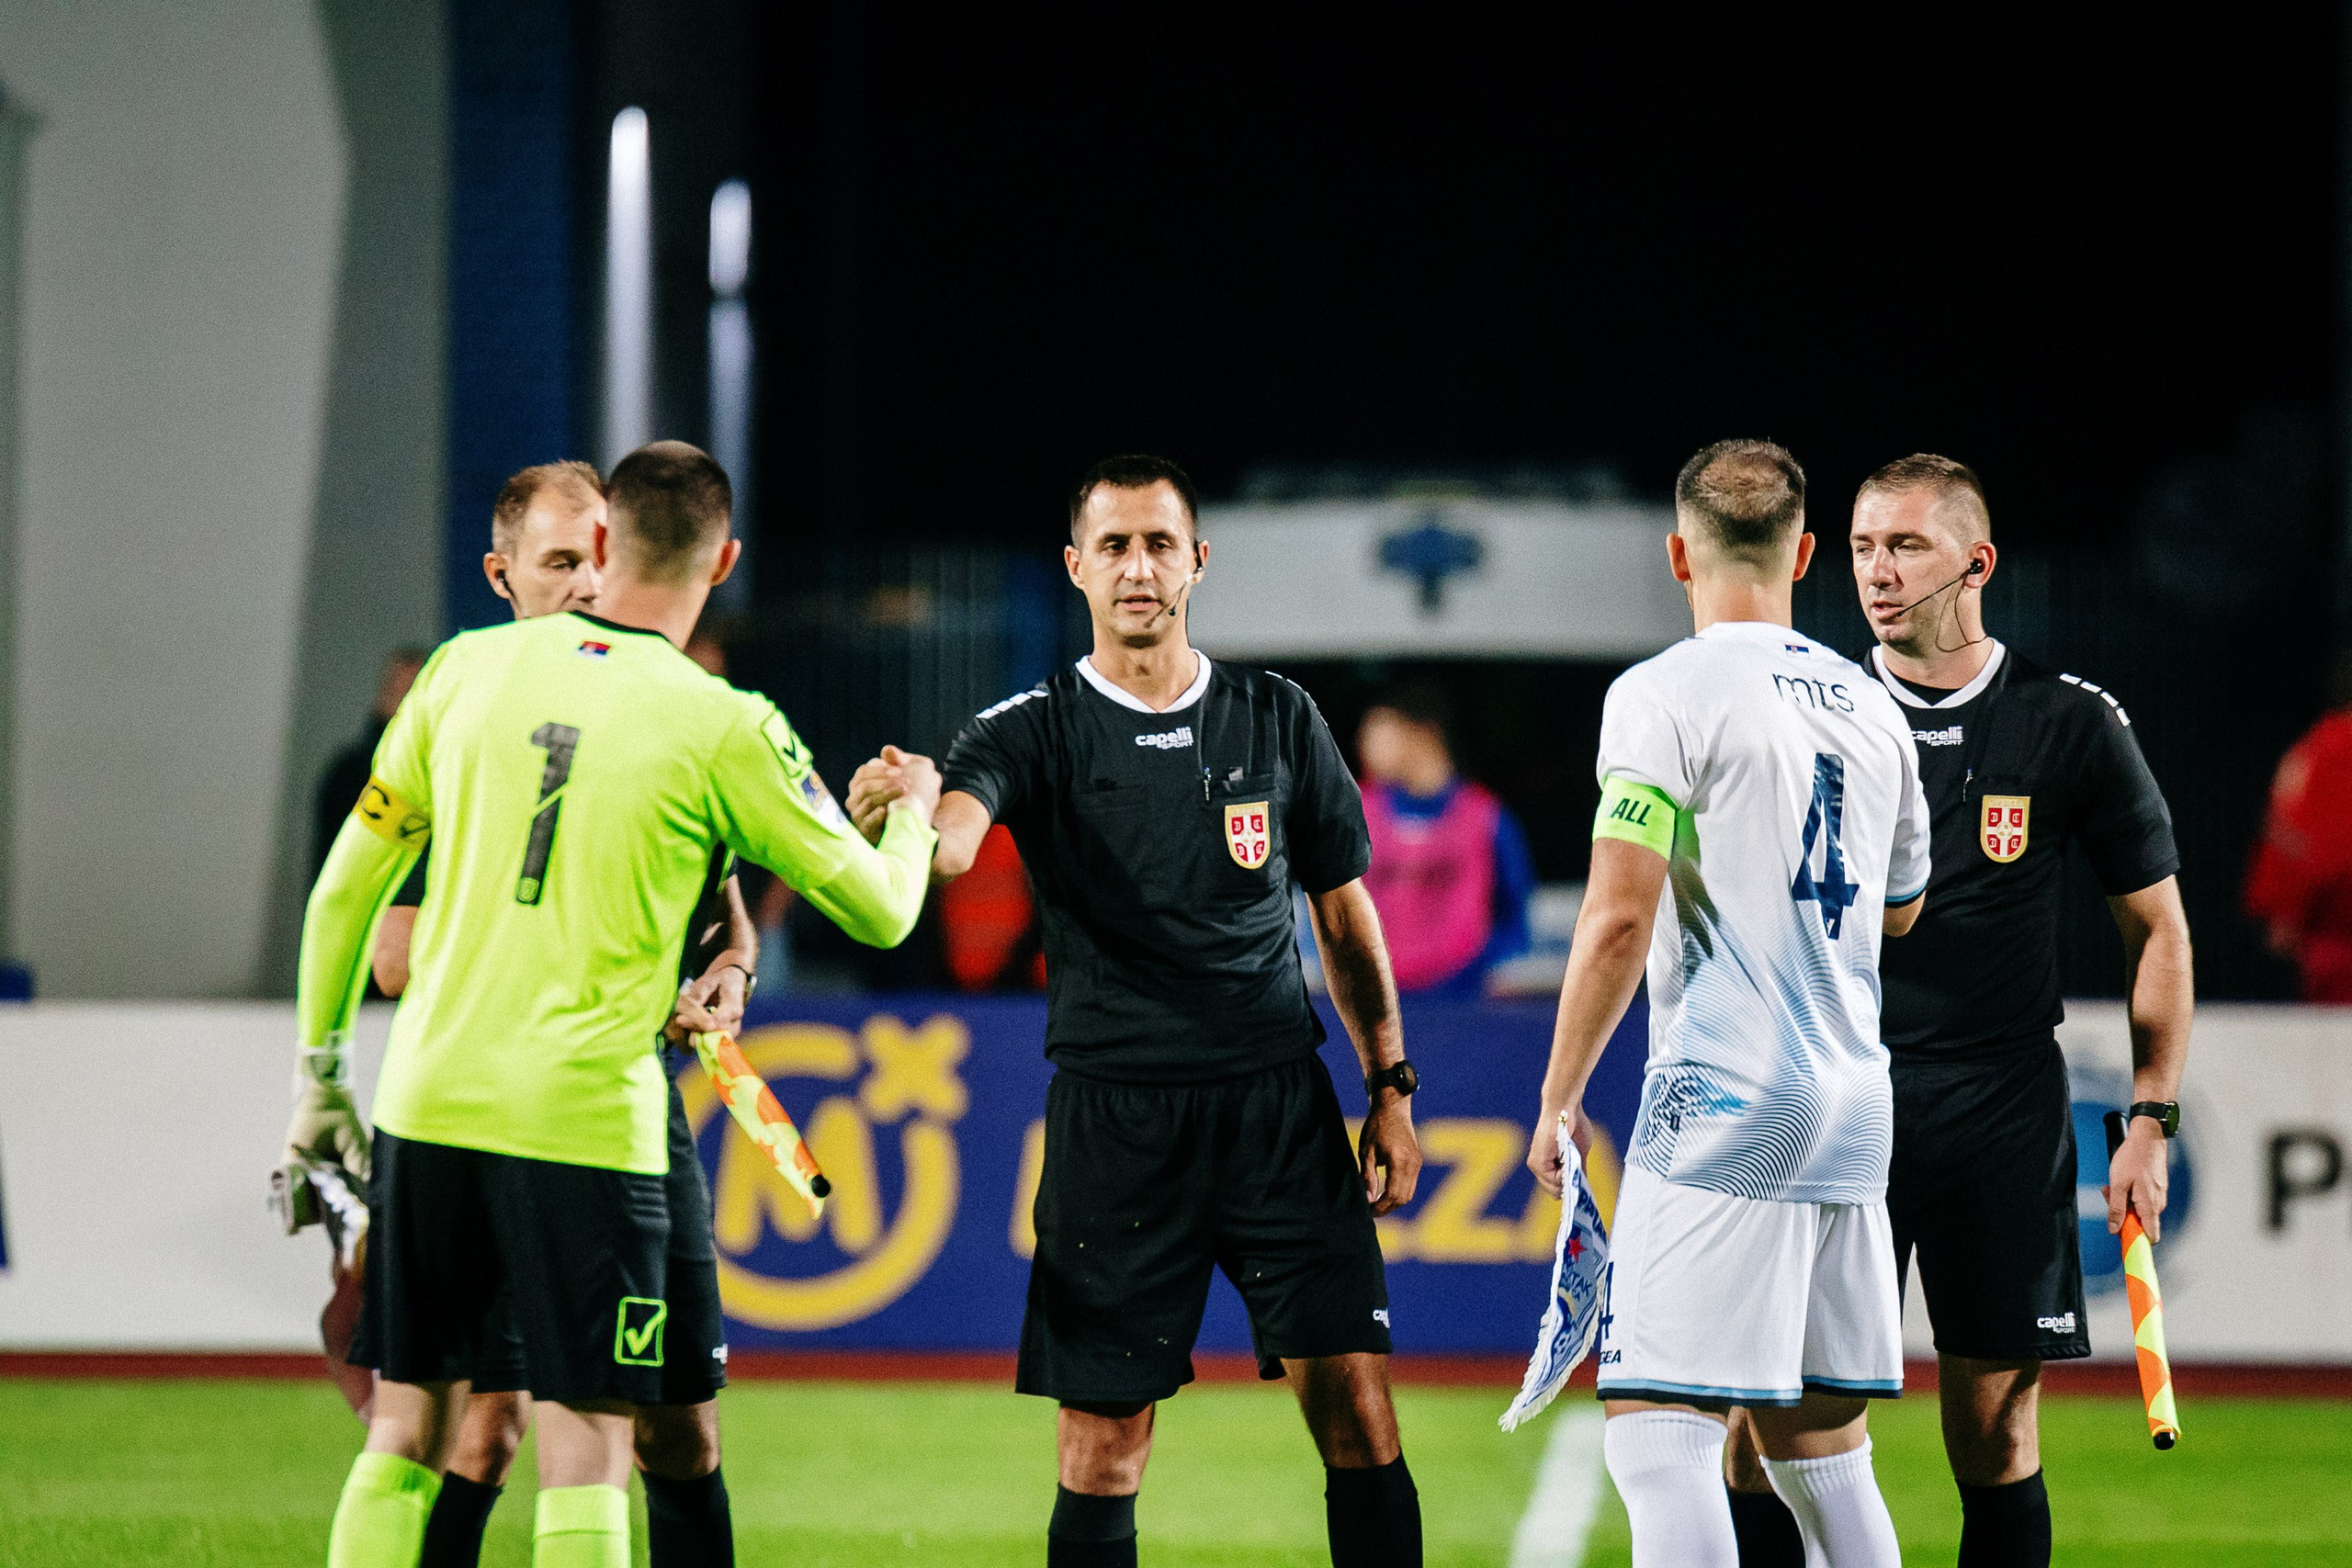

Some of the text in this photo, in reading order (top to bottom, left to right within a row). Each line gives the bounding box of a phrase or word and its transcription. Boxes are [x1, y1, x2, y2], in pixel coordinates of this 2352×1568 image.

[1772, 672, 1854, 713] mts
[1135, 726, 1193, 749] capelli
[530, 722, 580, 906] 1
[1603, 796, 1652, 827] ALL
[1792, 751, 1860, 941] 4
[2037, 1312, 2076, 1332] capelli
